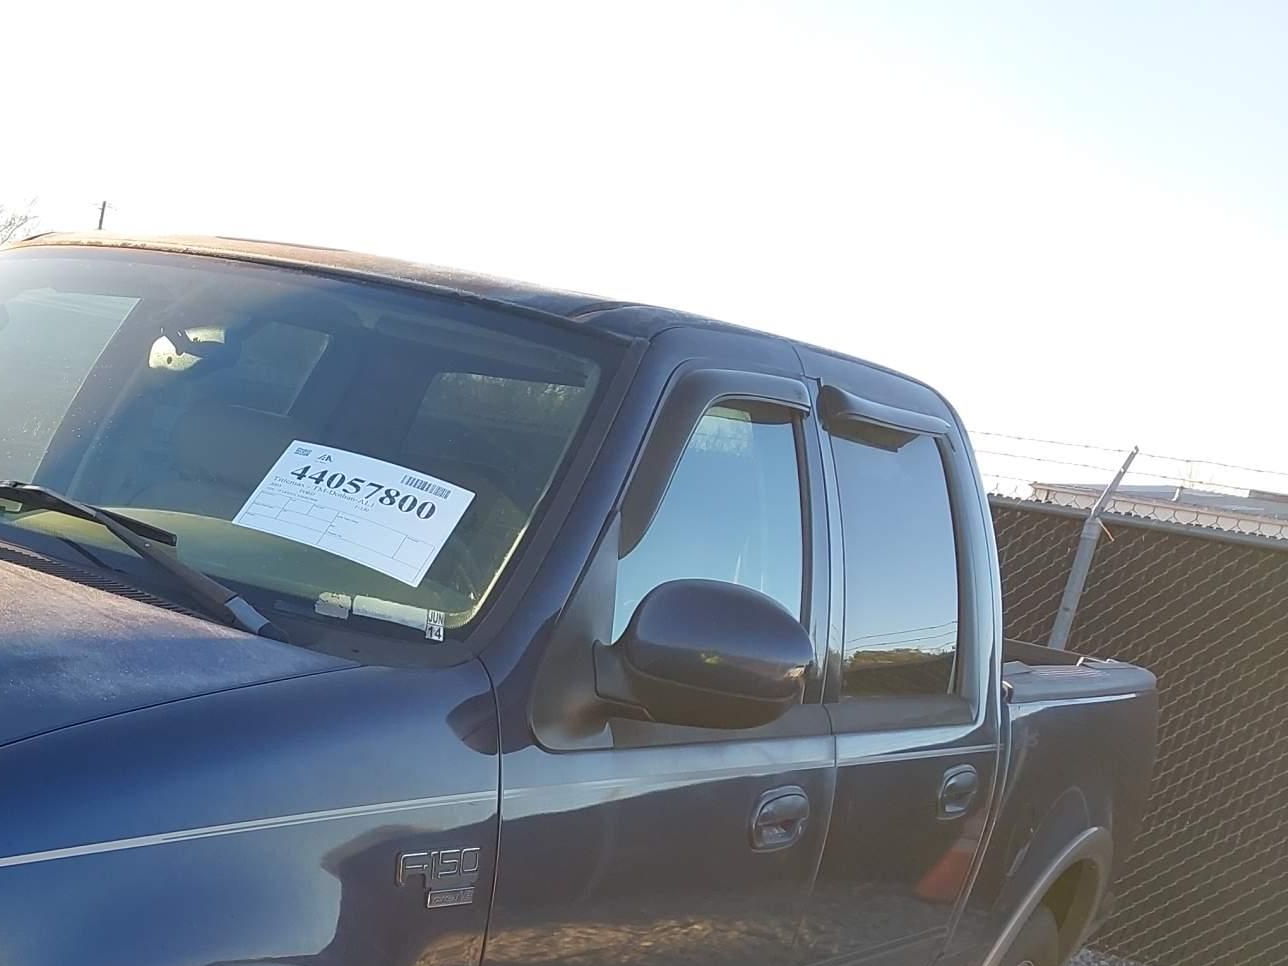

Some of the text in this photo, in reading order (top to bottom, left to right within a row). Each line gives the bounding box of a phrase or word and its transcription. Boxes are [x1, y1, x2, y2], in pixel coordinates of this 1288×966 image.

[290, 465, 436, 520] 44057800
[428, 610, 444, 624] JUN
[427, 625, 443, 640] 14
